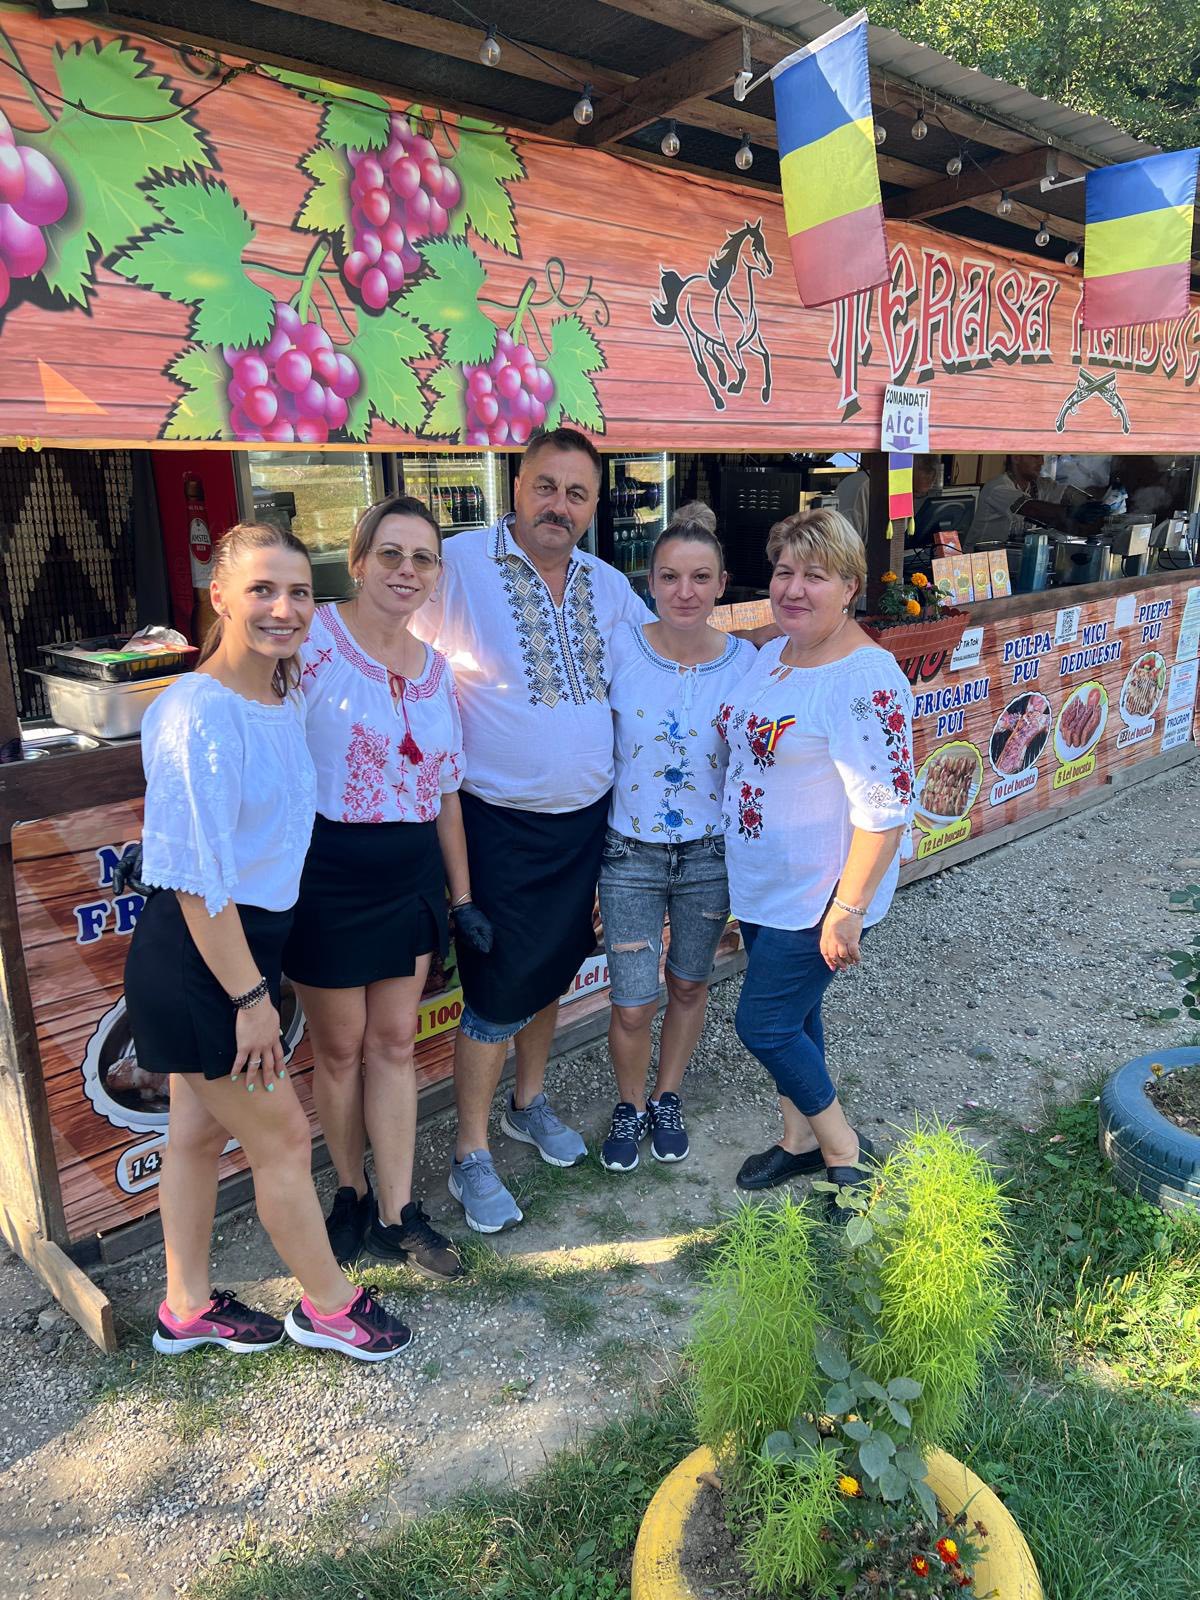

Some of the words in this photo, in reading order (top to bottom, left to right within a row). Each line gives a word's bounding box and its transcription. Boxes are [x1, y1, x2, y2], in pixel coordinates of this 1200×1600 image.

[192, 535, 210, 544] AMSTEL
[1139, 600, 1171, 622] PIEPT
[1082, 623, 1107, 646] MICI
[1142, 623, 1162, 643] PUI
[1004, 631, 1051, 662] PULPA
[1060, 642, 1122, 675] DEDULESTI
[1012, 659, 1040, 684] PUI
[914, 678, 989, 717] FRIGARUI
[937, 711, 964, 737] PUI
[1167, 713, 1190, 729] PROGRAM
[1063, 766, 1072, 780] Lei
[994, 786, 1003, 800] 10
[1004, 780, 1014, 796] Lei
[1014, 774, 1036, 792] bucata
[932, 834, 944, 849] Lei
[428, 1001, 462, 1029] 100
